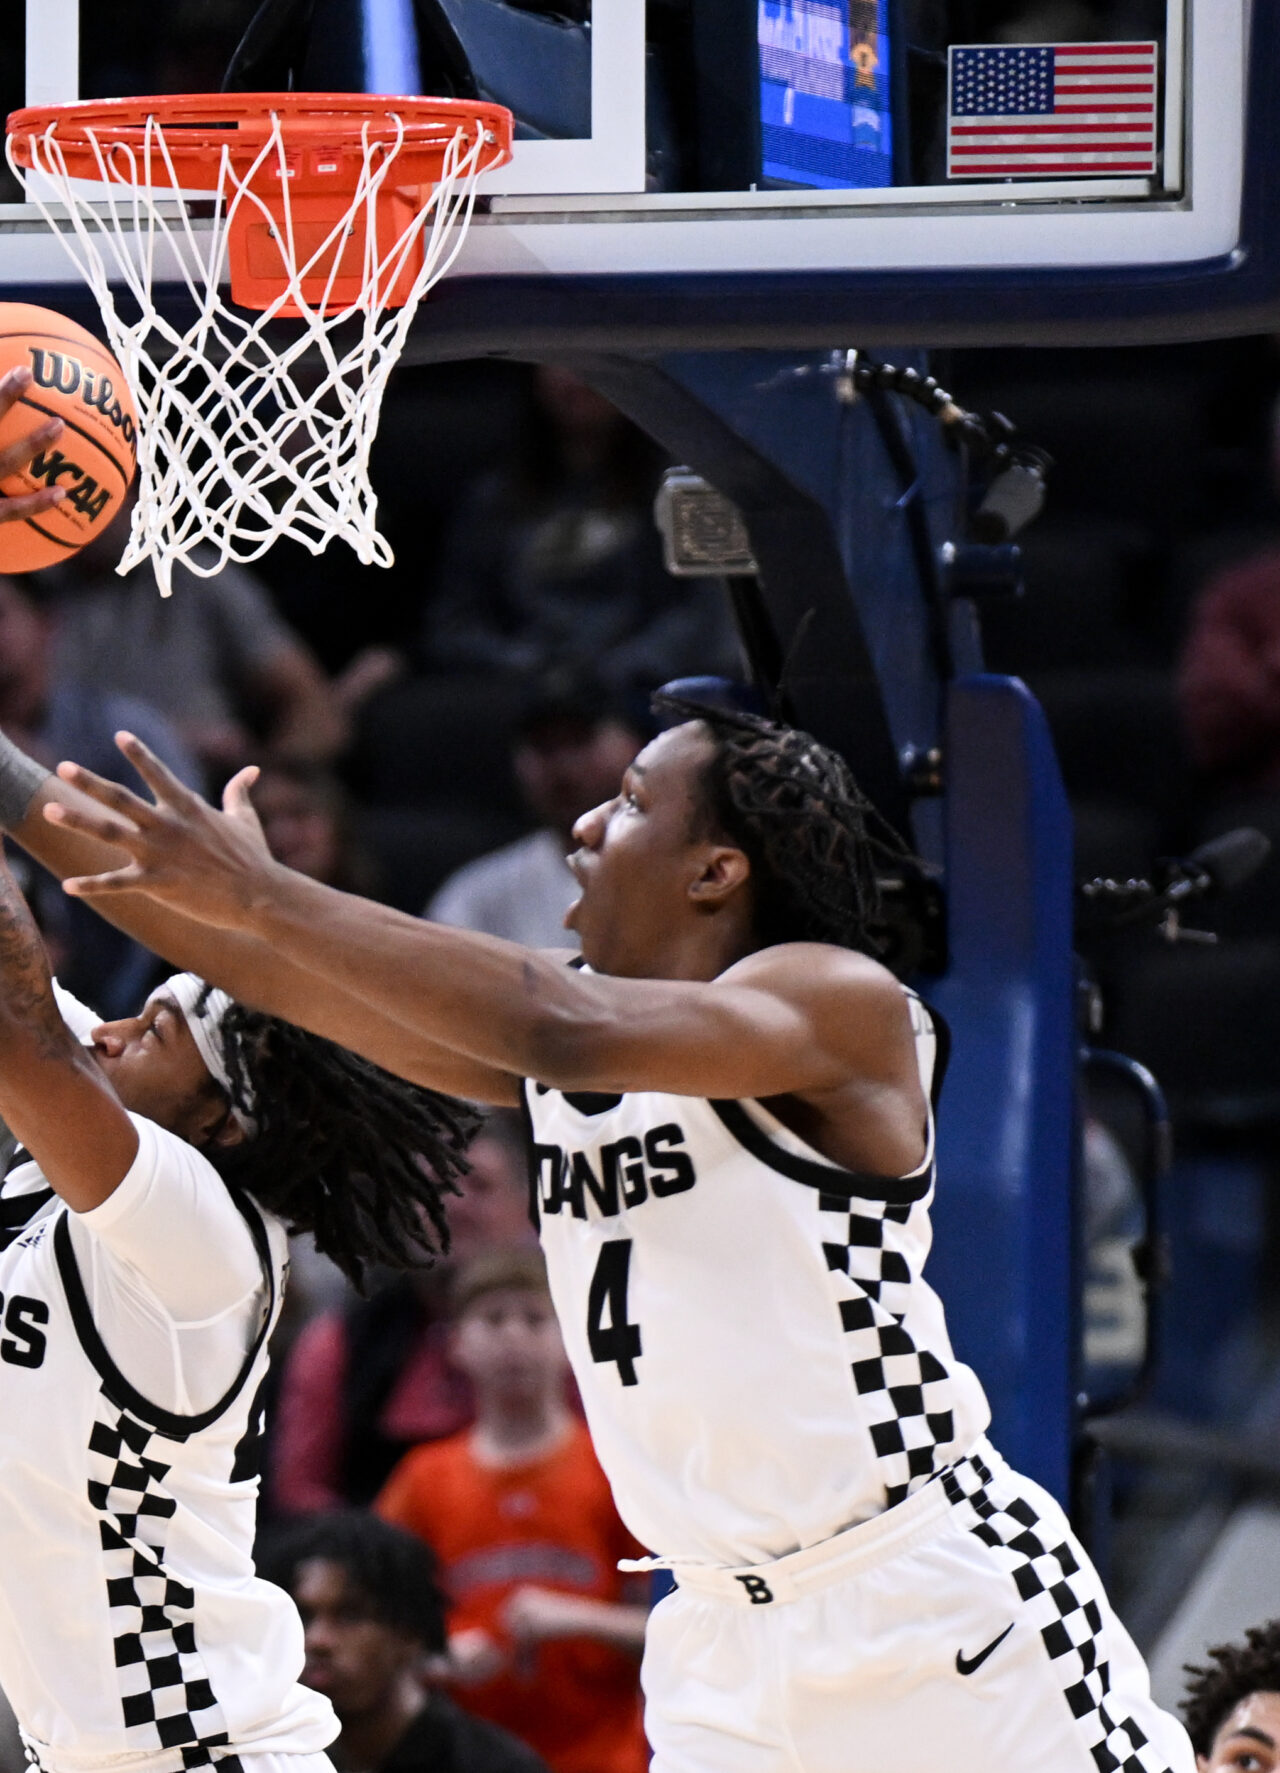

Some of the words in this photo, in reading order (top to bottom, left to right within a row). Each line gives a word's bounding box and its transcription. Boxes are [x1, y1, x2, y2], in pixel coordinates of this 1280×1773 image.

[30, 450, 112, 523] NCAA
[587, 1238, 642, 1386] 4
[734, 1574, 773, 1604] B
